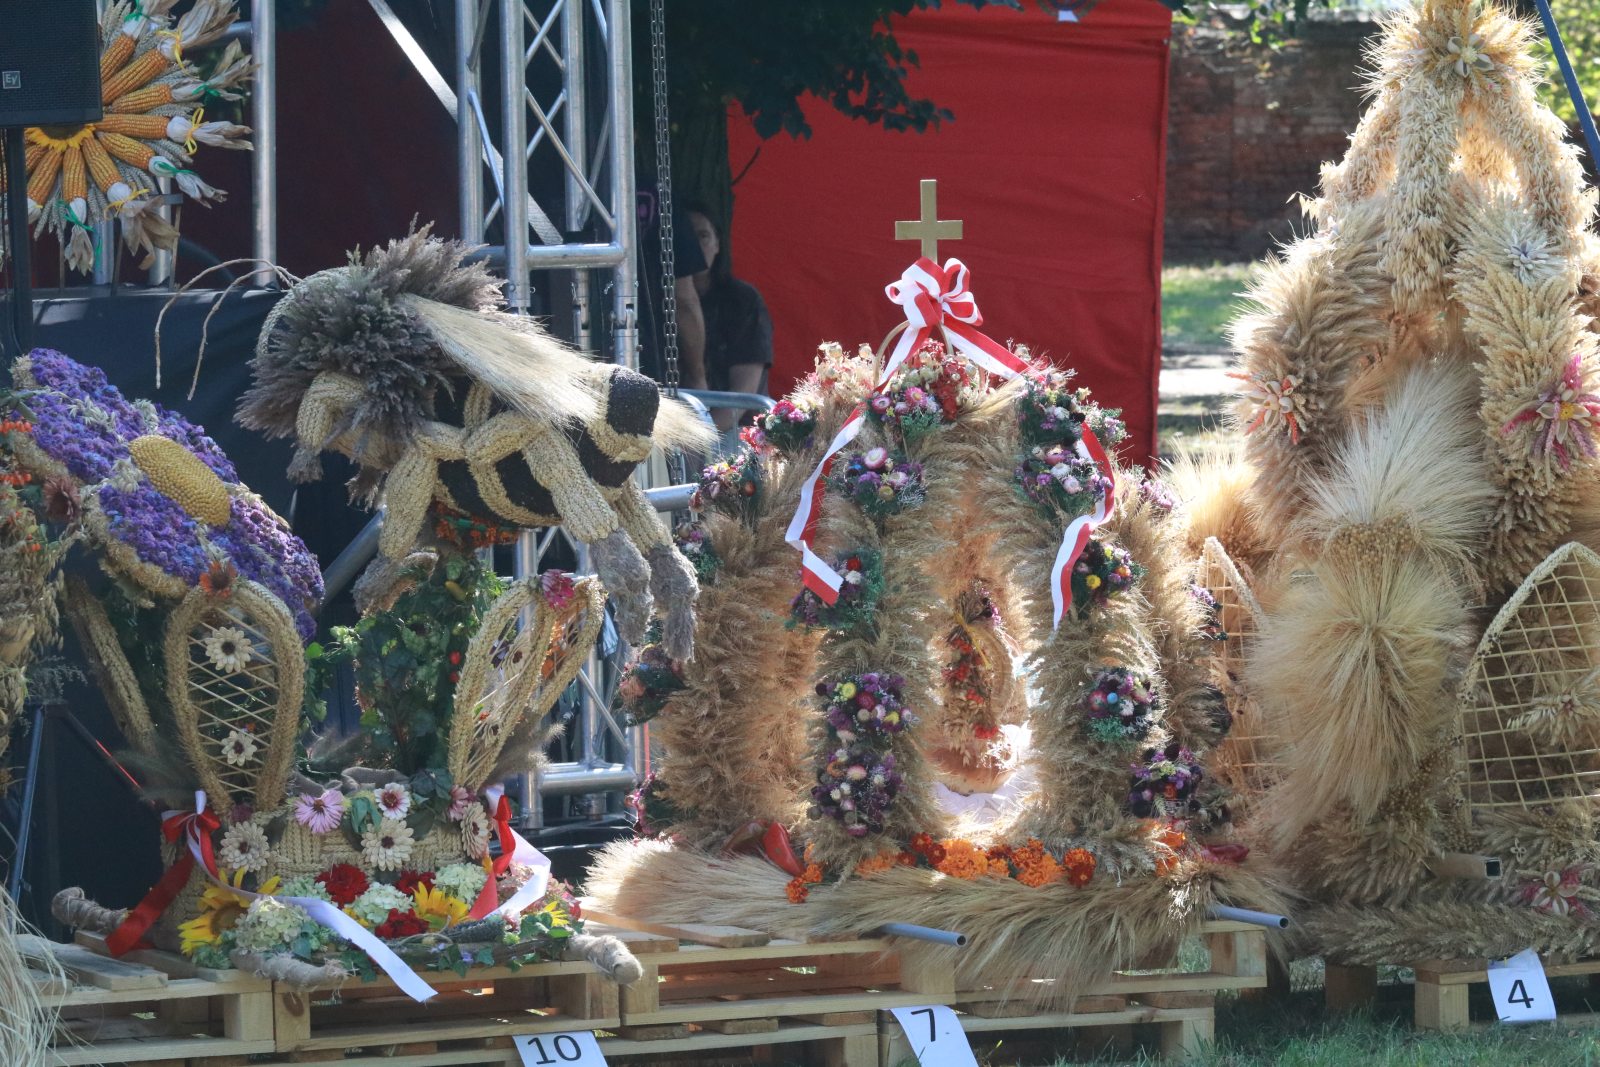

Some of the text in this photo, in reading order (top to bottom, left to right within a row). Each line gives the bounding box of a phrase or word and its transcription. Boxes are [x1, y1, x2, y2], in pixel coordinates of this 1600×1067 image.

[1507, 979, 1535, 1010] 4
[910, 1007, 936, 1043] 7
[527, 1034, 582, 1065] 10
